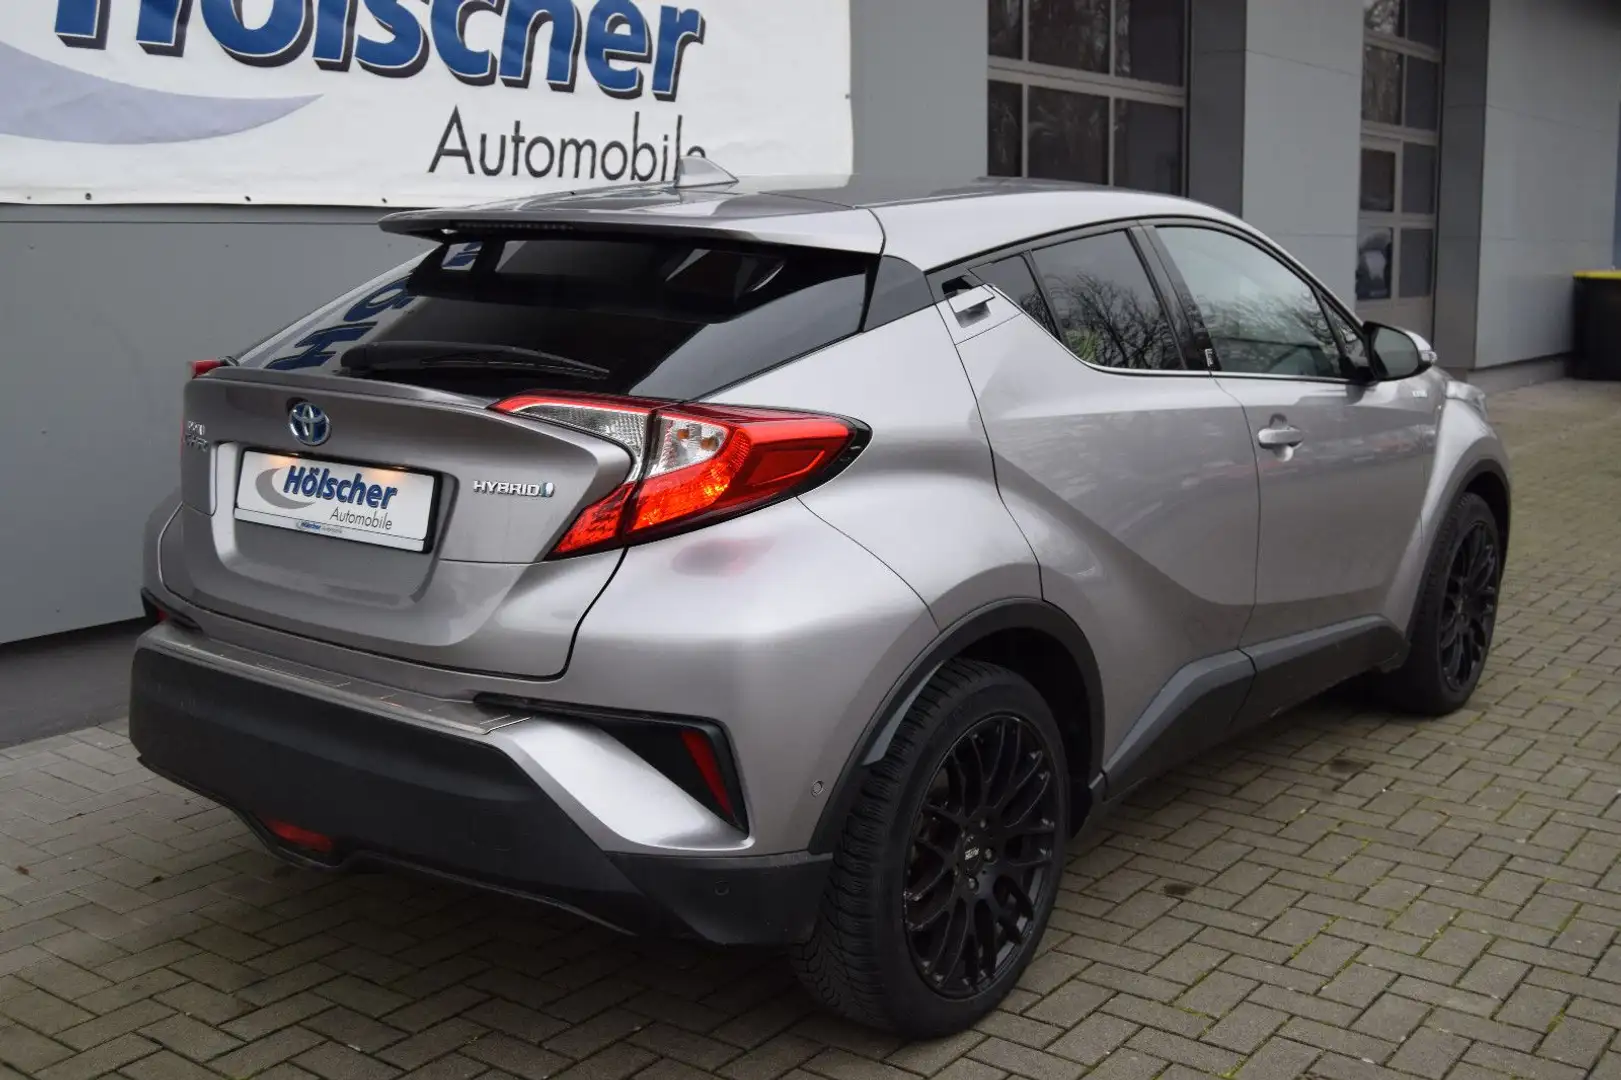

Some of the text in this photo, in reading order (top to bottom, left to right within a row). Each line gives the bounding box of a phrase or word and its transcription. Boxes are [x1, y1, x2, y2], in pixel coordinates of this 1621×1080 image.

[283, 465, 398, 509] Hölscher
[473, 480, 540, 497] HYBRID
[329, 506, 393, 530] Automobile
